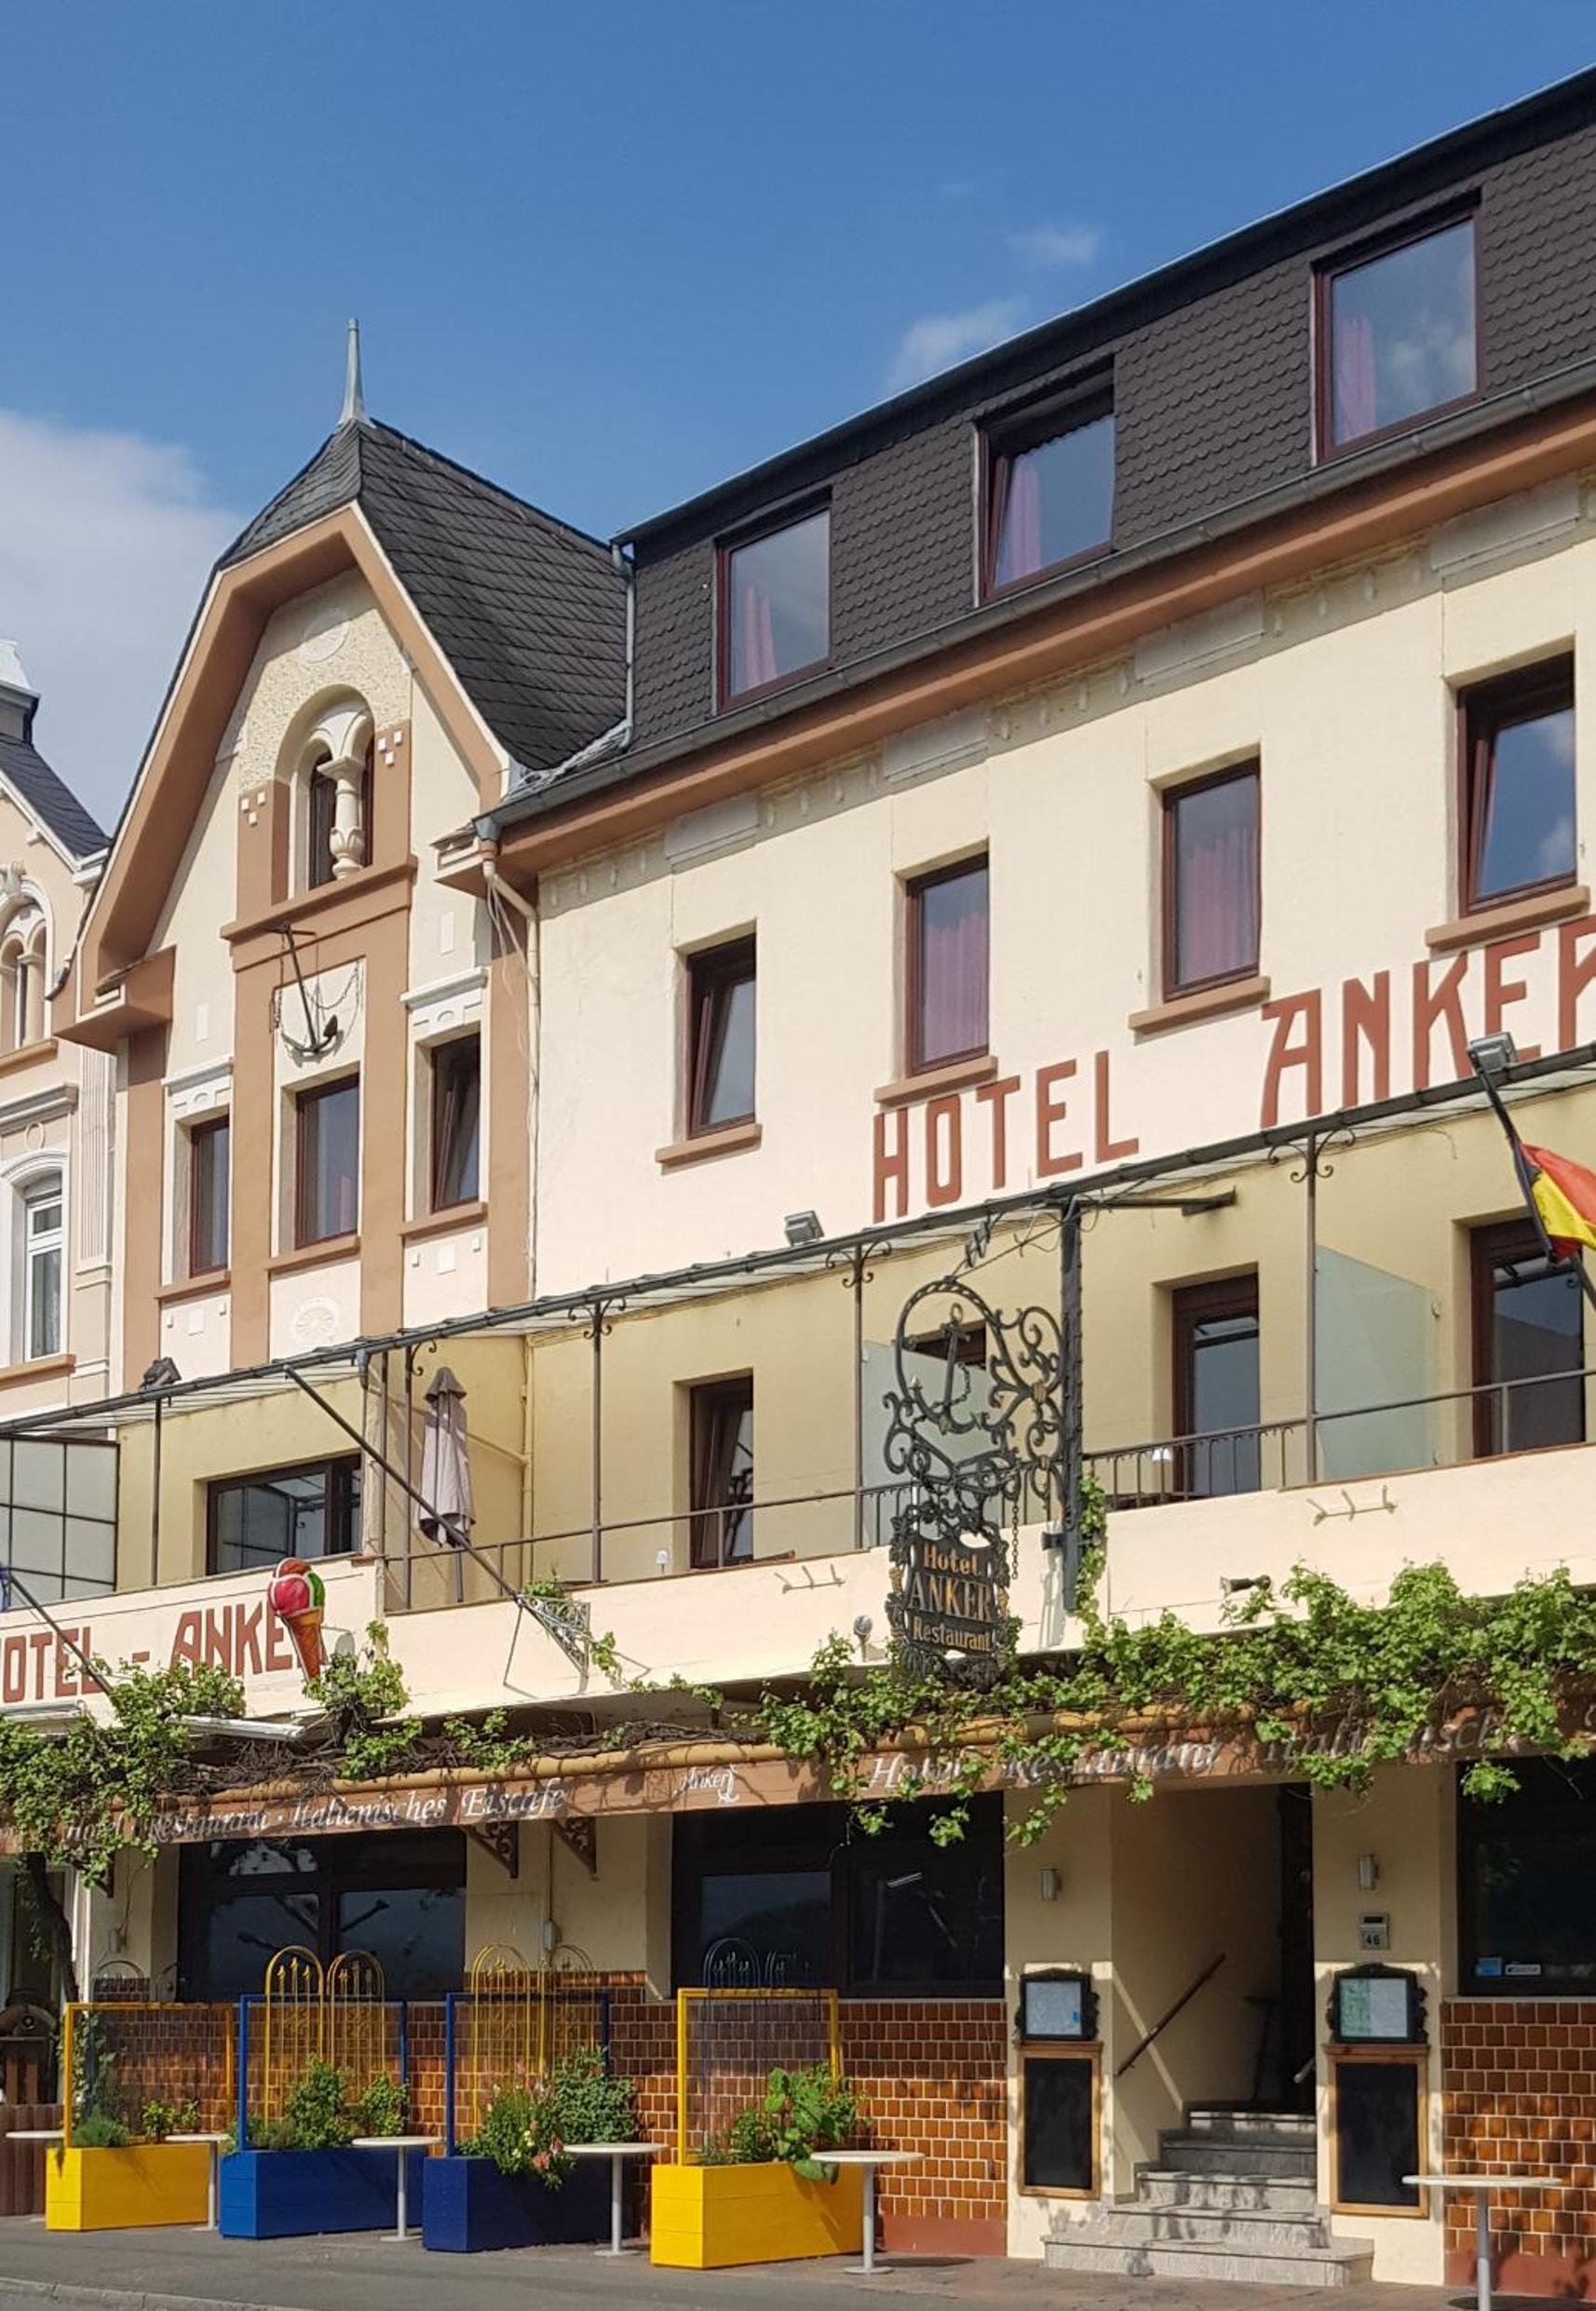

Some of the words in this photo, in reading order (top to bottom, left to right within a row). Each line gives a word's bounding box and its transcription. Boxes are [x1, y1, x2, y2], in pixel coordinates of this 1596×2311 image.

[873, 1049, 1140, 1223] HOTEL
[923, 1543, 981, 1577] Hotel
[907, 1570, 994, 1623] ANKER
[0, 1626, 107, 1703] OTEL
[168, 1601, 328, 1677] ANKE
[913, 1615, 992, 1649] Restaurant
[1365, 1934, 1380, 1945] 46
